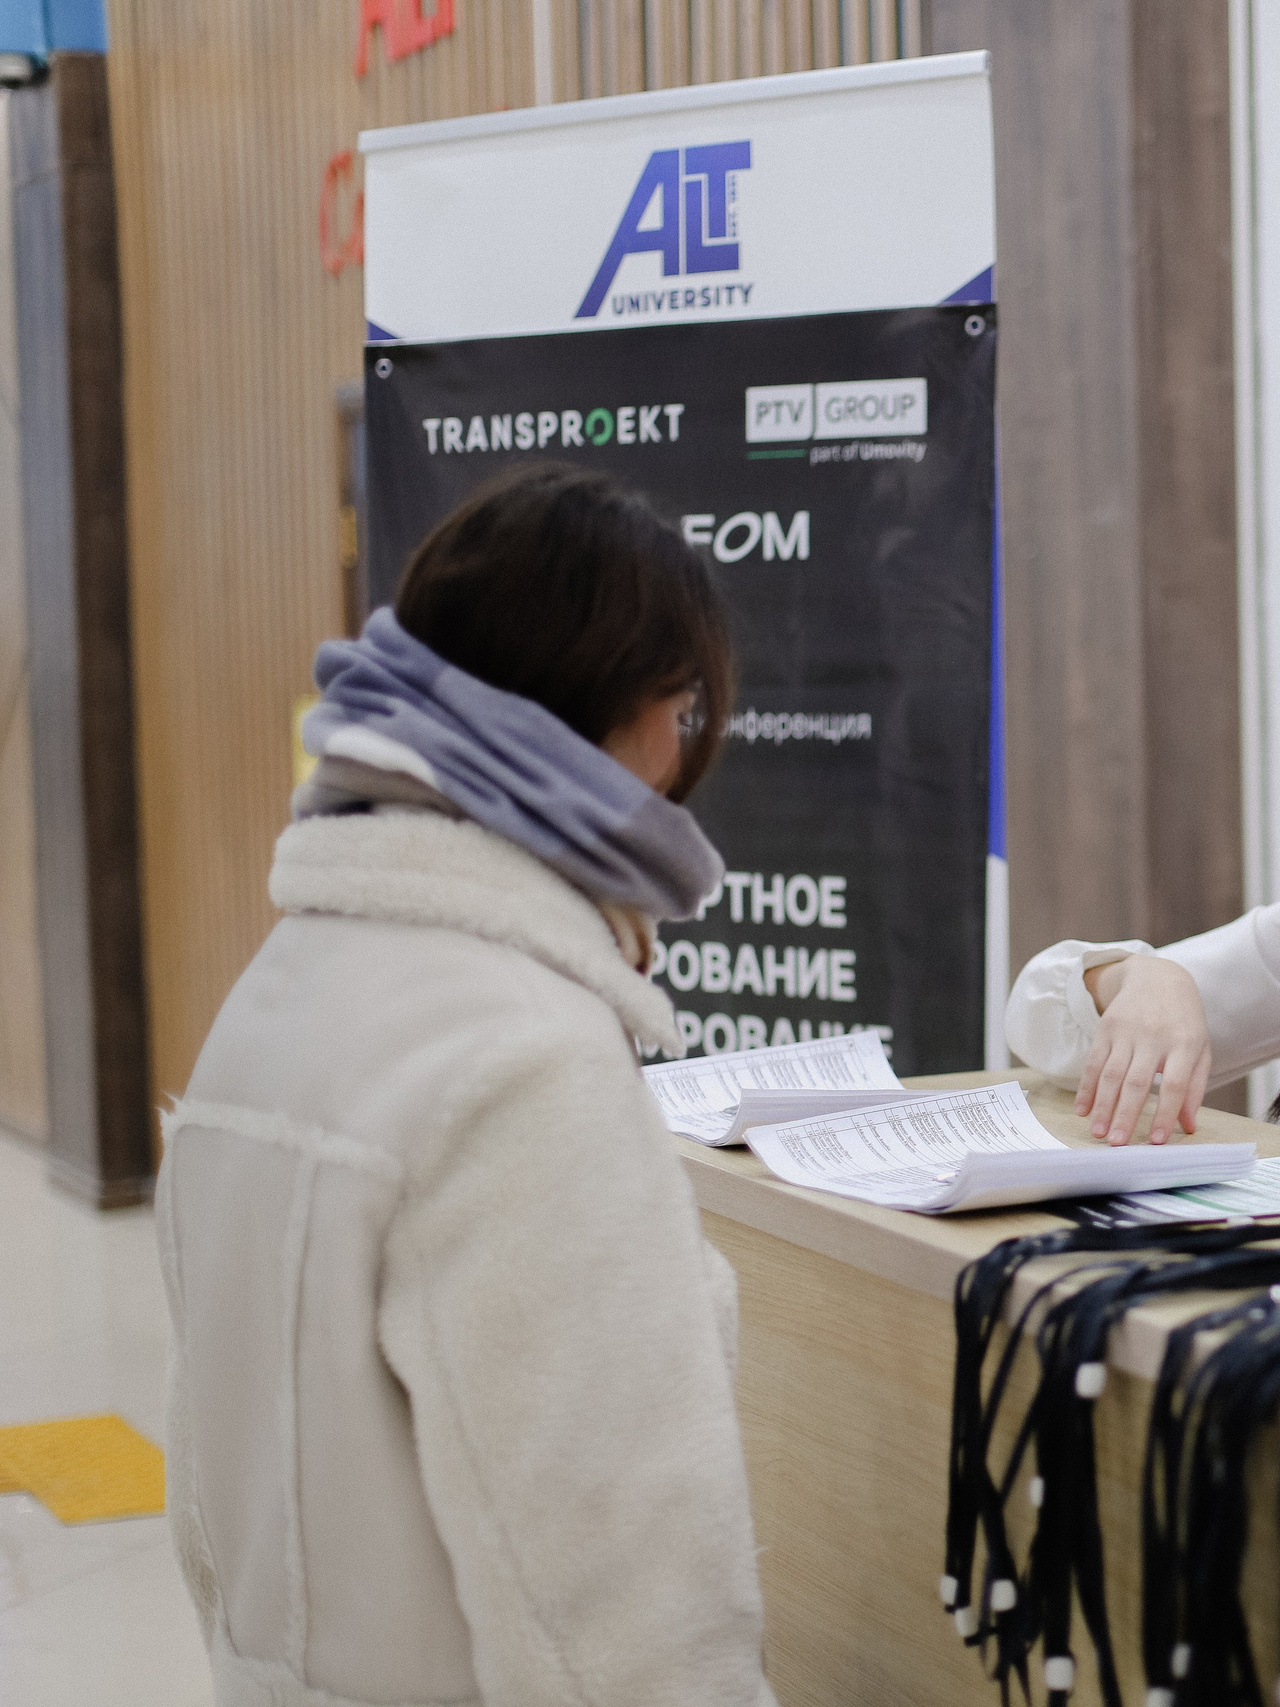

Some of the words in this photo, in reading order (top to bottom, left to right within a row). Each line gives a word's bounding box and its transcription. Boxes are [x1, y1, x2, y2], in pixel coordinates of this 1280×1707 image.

[574, 139, 751, 319] ALT
[612, 281, 753, 316] UNIVERSITY
[422, 402, 686, 455] TRANSPROEKT
[755, 399, 805, 426] PTV
[824, 393, 916, 424] GROUP
[650, 938, 858, 1002] РОВАНИЕ
